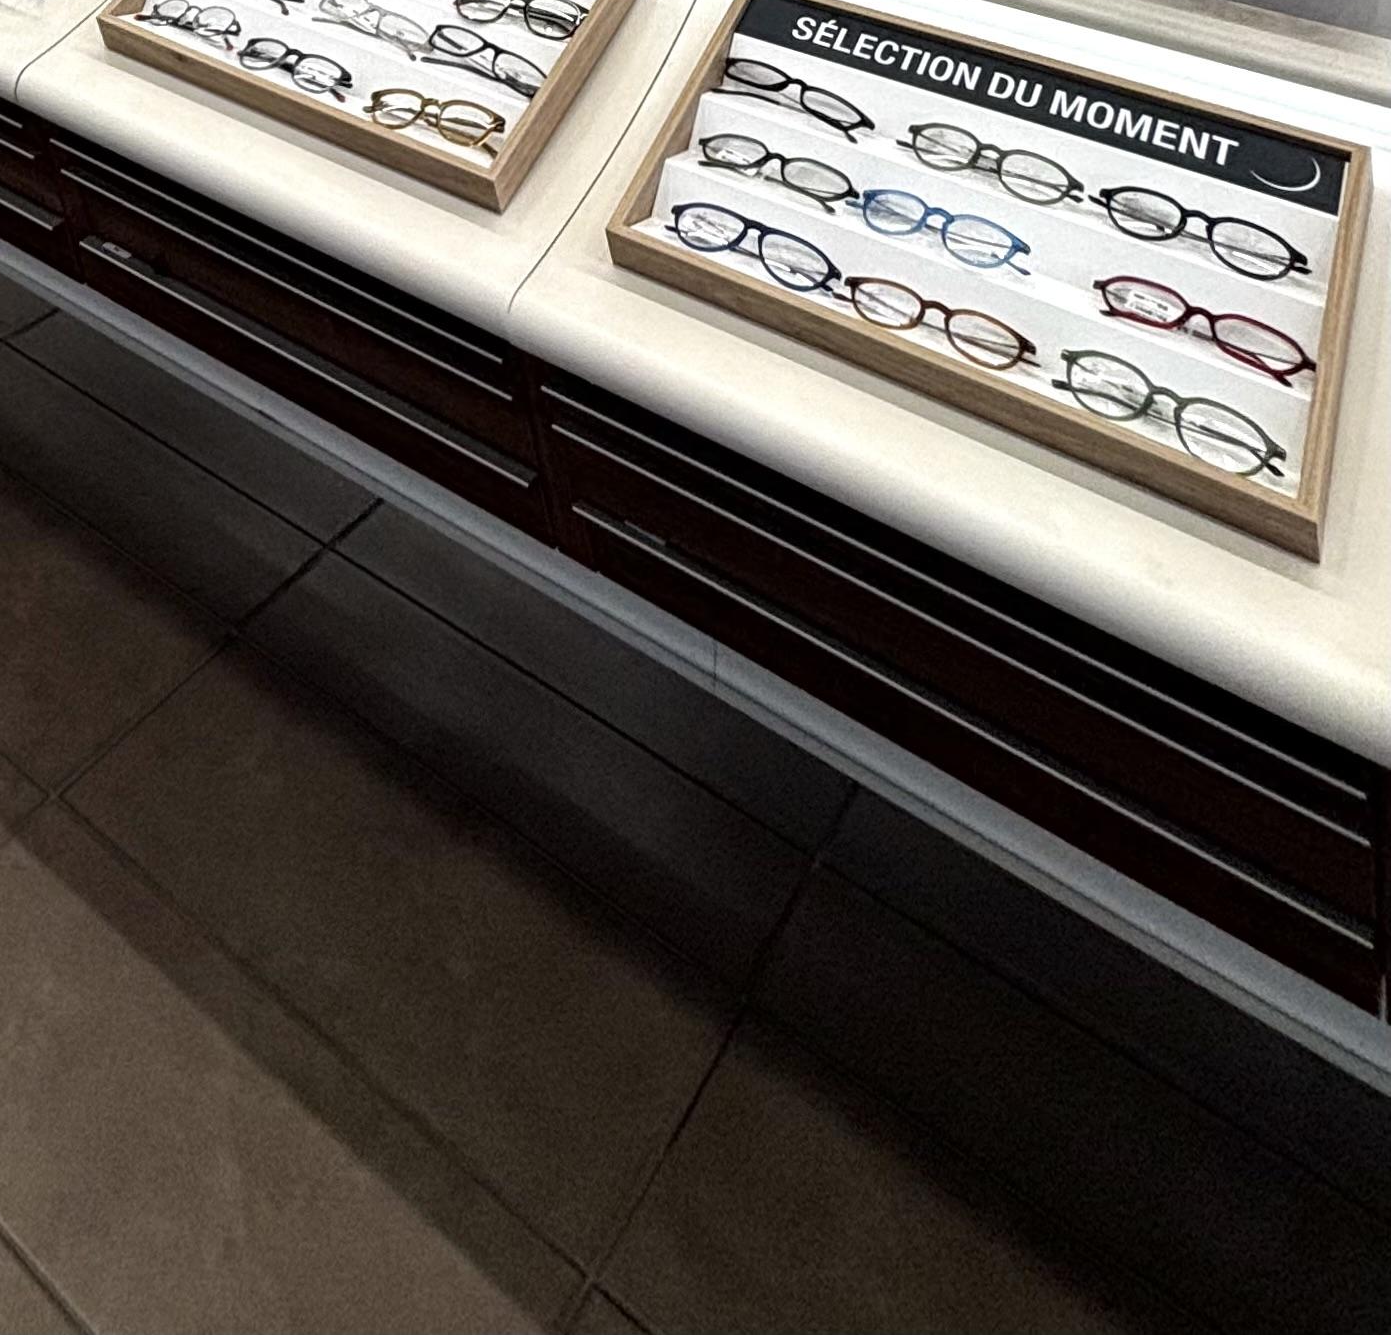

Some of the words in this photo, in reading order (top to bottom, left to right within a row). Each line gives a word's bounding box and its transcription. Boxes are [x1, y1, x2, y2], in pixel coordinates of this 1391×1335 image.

[790, 15, 981, 93] SÉLECTION
[985, 71, 1044, 112] DU
[1048, 86, 1241, 169] MOMENT
